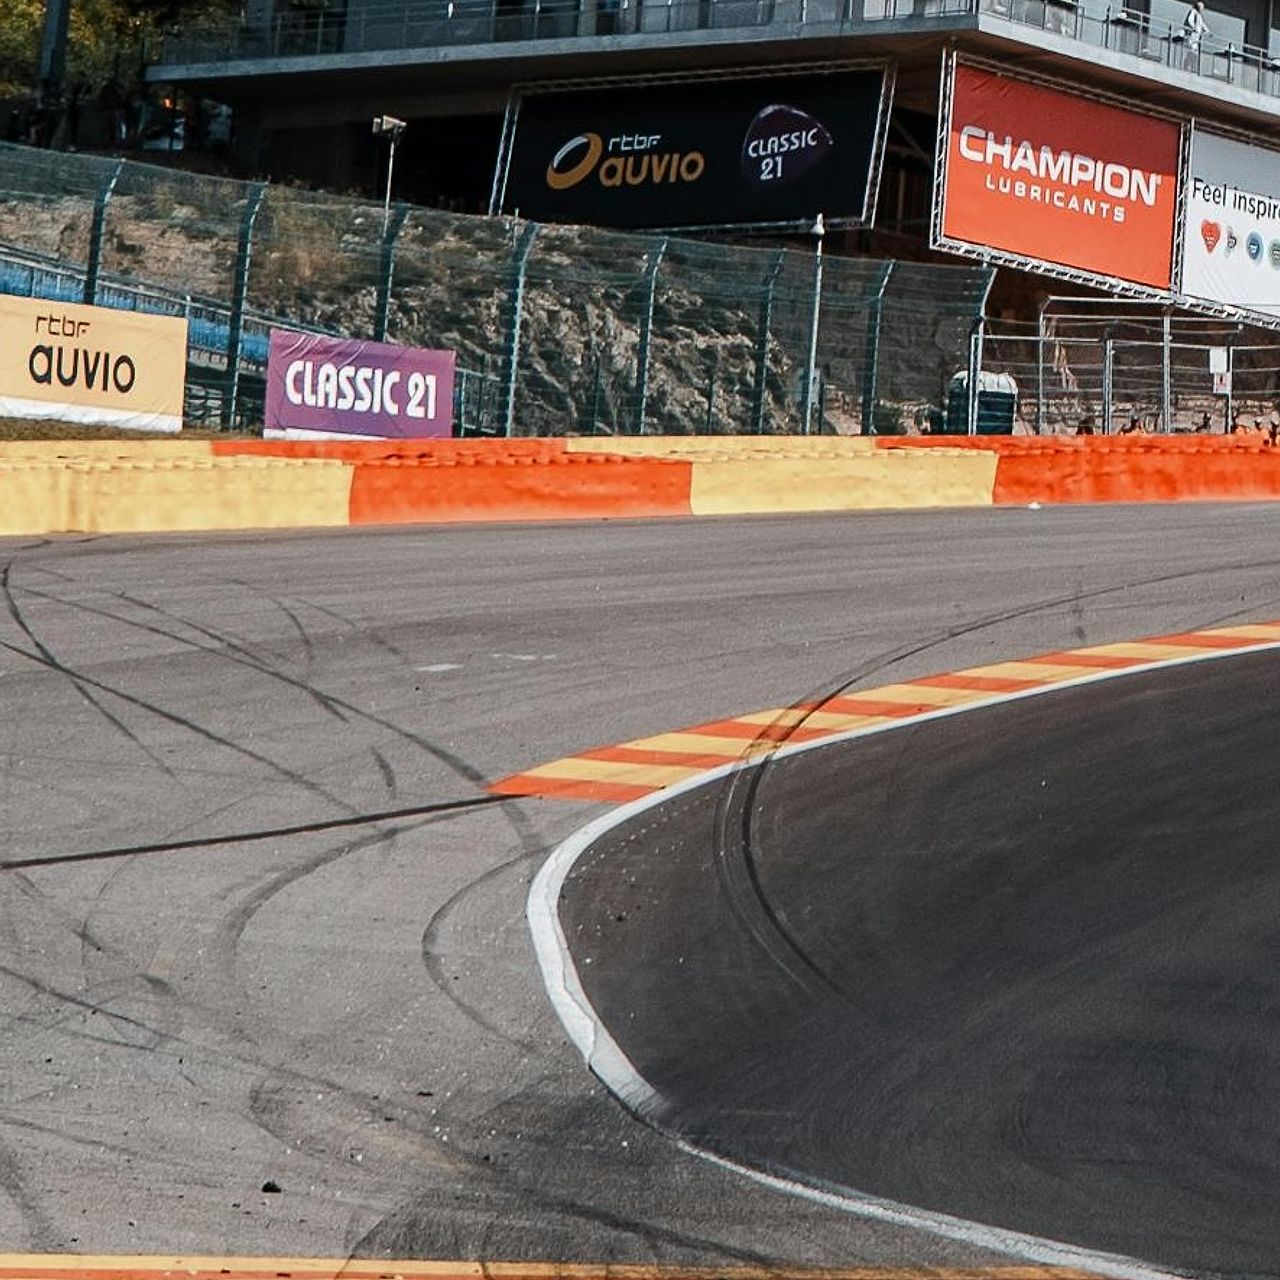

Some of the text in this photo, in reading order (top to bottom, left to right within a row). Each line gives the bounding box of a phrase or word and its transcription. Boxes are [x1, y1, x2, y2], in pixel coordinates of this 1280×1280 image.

[748, 127, 819, 158] CLASSIC
[760, 156, 783, 181] 21
[959, 125, 1159, 207] CHAMPION
[985, 173, 1126, 223] LUBRICANTS
[1192, 177, 1227, 207] Feel
[285, 360, 437, 420] CLASSIC 21
